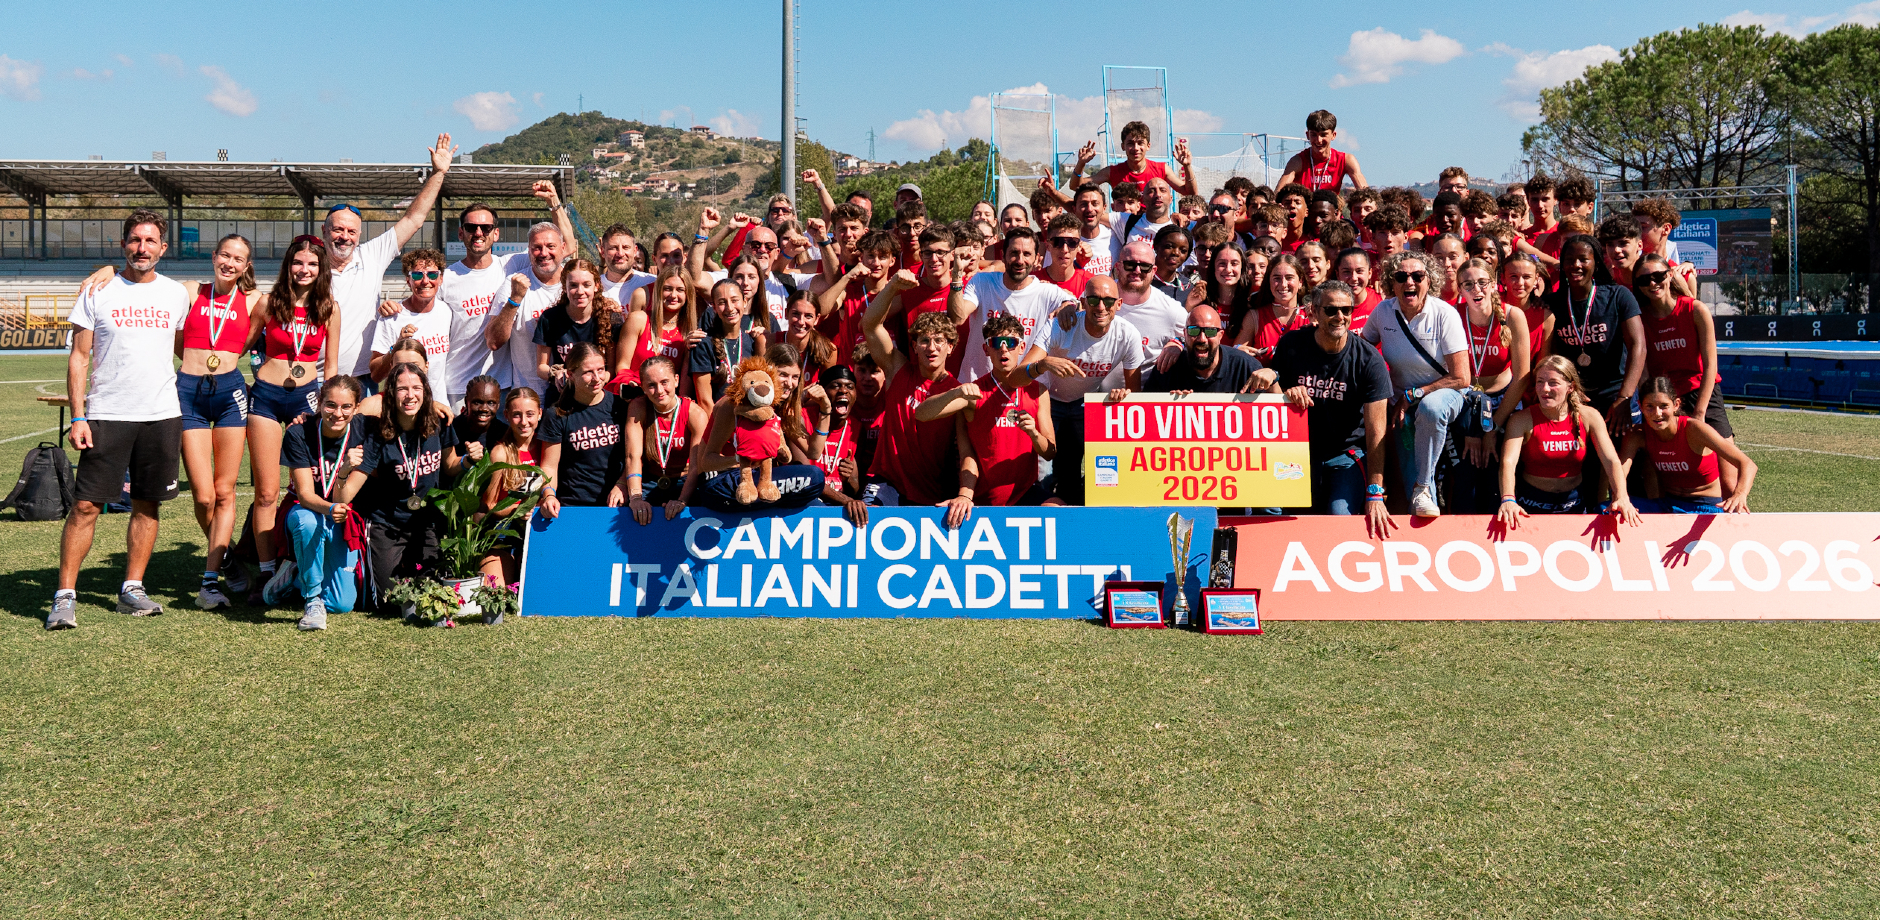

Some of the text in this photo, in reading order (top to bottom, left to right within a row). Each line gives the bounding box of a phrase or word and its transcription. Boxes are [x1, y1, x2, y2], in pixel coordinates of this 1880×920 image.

[1673, 229, 1711, 238] italiana
[111, 306, 170, 320] atletica
[115, 318, 169, 329] veneta
[0, 330, 68, 347] GOLDEN
[1654, 338, 1686, 351] VENETO
[646, 340, 679, 358] VNETO
[1298, 375, 1347, 391] atletica
[1308, 387, 1343, 400] eneta
[1105, 405, 1289, 440] HO VINTO IO!
[569, 423, 620, 442] atletica
[572, 434, 620, 451] veneta
[1543, 440, 1580, 452] VENETO
[1130, 446, 1267, 472] AGROPOLI
[1655, 461, 1689, 472] VENETO
[772, 476, 812, 495] VENE
[1163, 475, 1238, 501] 2026
[1518, 496, 1551, 510] NIKE
[684, 516, 1057, 560] CAMPIONATI
[1272, 540, 1874, 593] AGROPOLI 2026
[609, 563, 858, 608] ITALIANI
